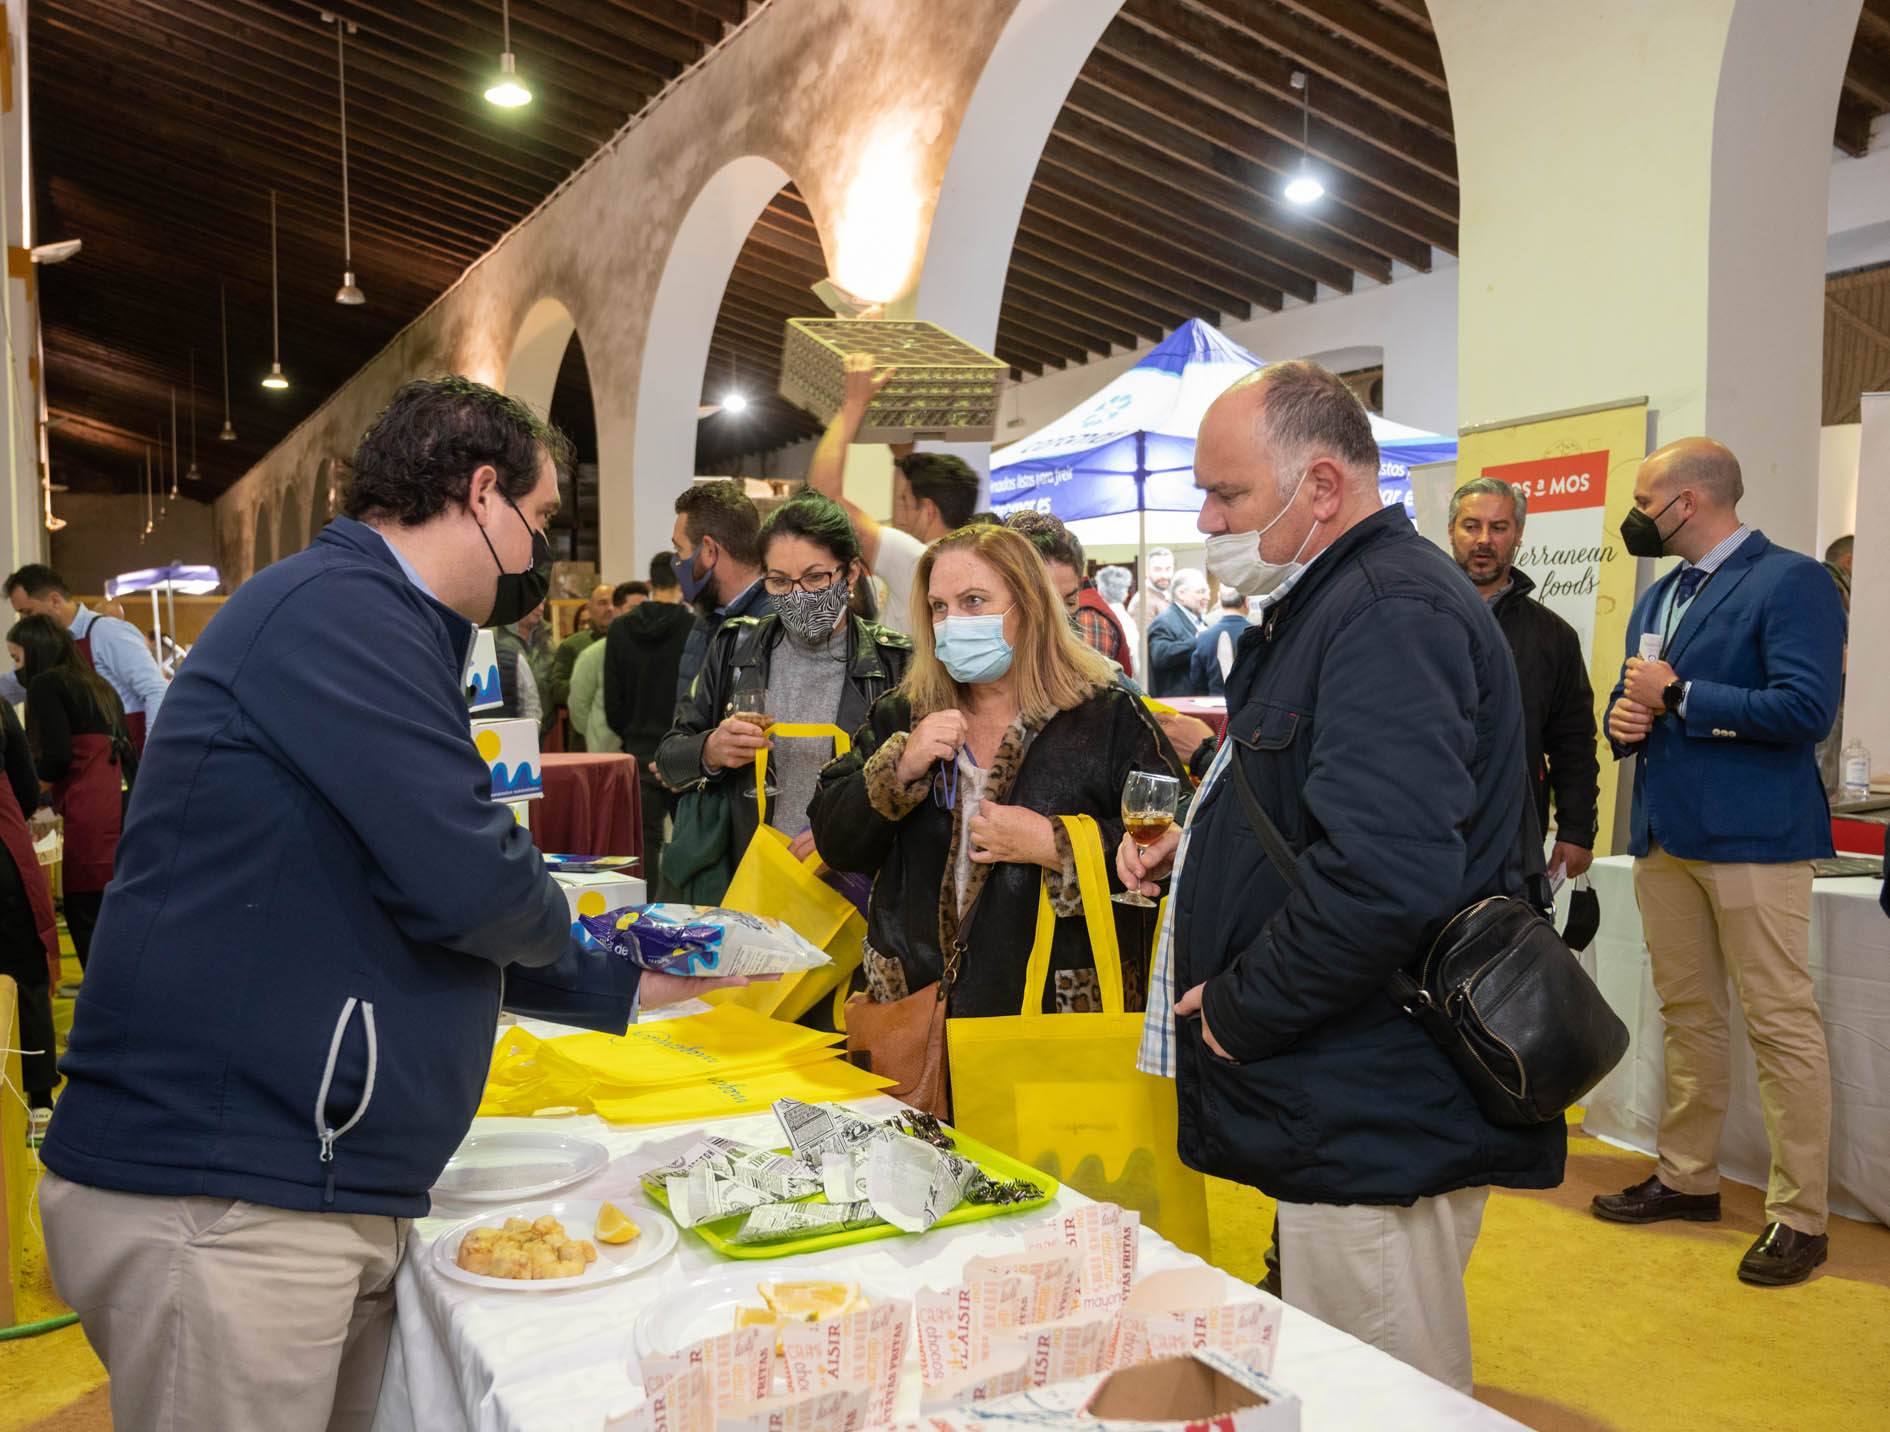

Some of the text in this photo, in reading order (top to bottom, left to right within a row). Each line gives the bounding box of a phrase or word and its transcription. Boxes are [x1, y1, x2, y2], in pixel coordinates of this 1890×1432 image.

[1550, 473, 1590, 495] MOS
[1538, 566, 1600, 606] foods
[1122, 1226, 1132, 1269] FRITAS
